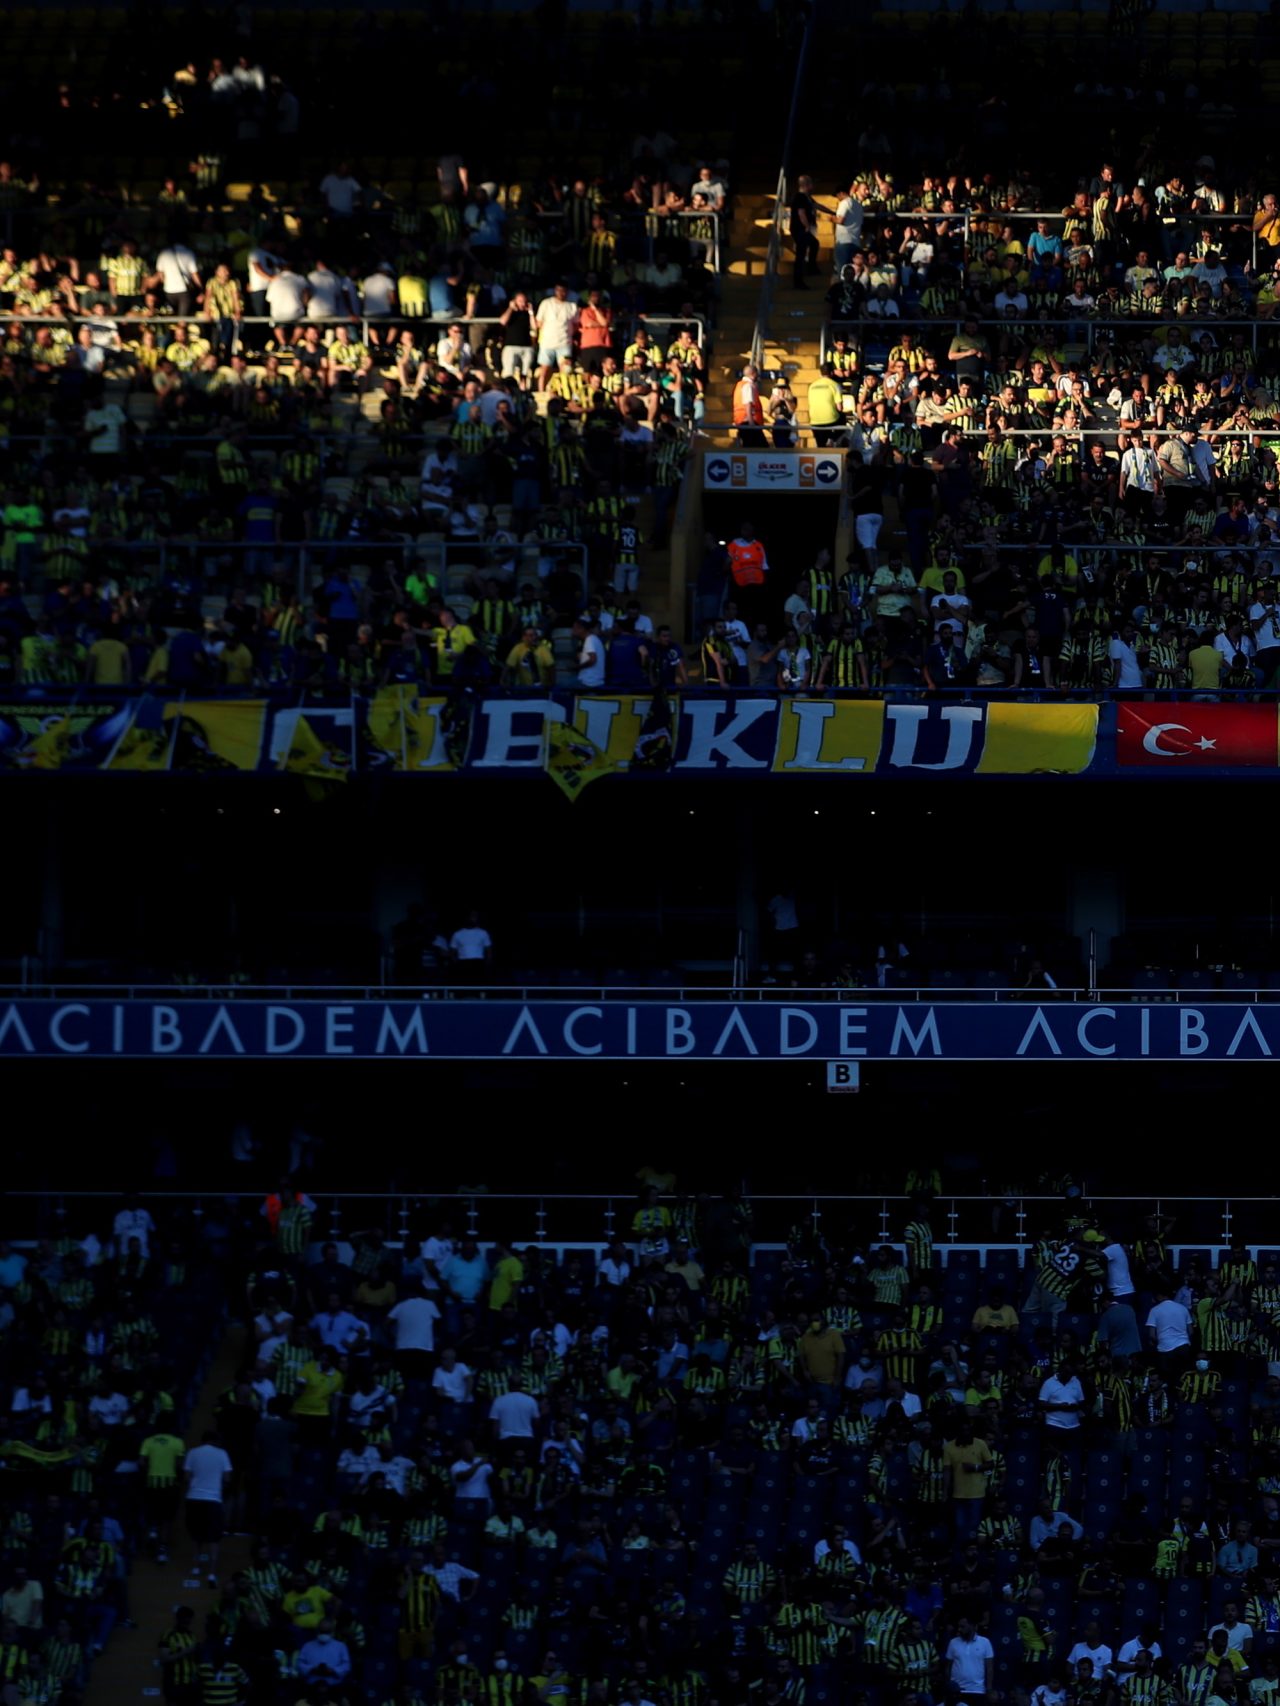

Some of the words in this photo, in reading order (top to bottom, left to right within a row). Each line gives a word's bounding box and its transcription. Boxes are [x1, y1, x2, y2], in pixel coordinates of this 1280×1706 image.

[733, 463, 744, 477] B
[801, 463, 813, 477] C
[501, 1005, 945, 1054] ACIBADEM
[836, 1064, 850, 1083] B
[1054, 1245, 1079, 1270] 23
